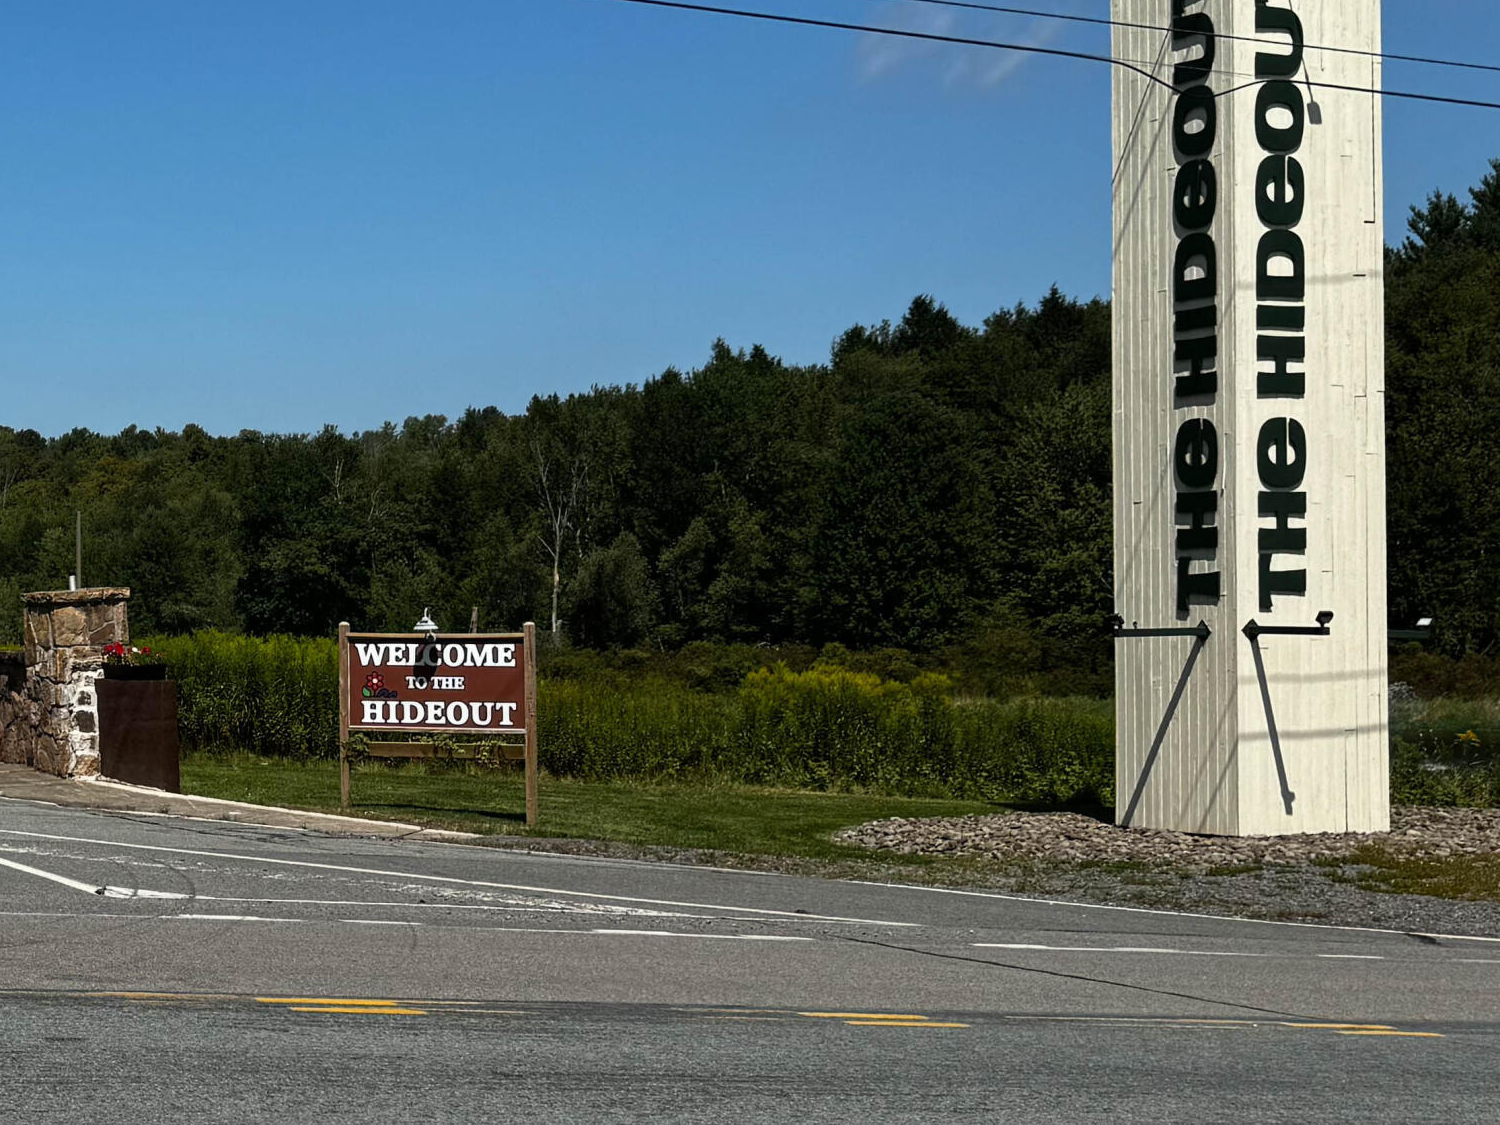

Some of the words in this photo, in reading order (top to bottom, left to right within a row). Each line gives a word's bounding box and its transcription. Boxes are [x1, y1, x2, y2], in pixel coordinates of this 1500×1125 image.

[354, 642, 517, 668] WELCOME
[405, 676, 428, 690] TO
[431, 676, 465, 690] THE
[360, 700, 518, 726] HIDEOUT
